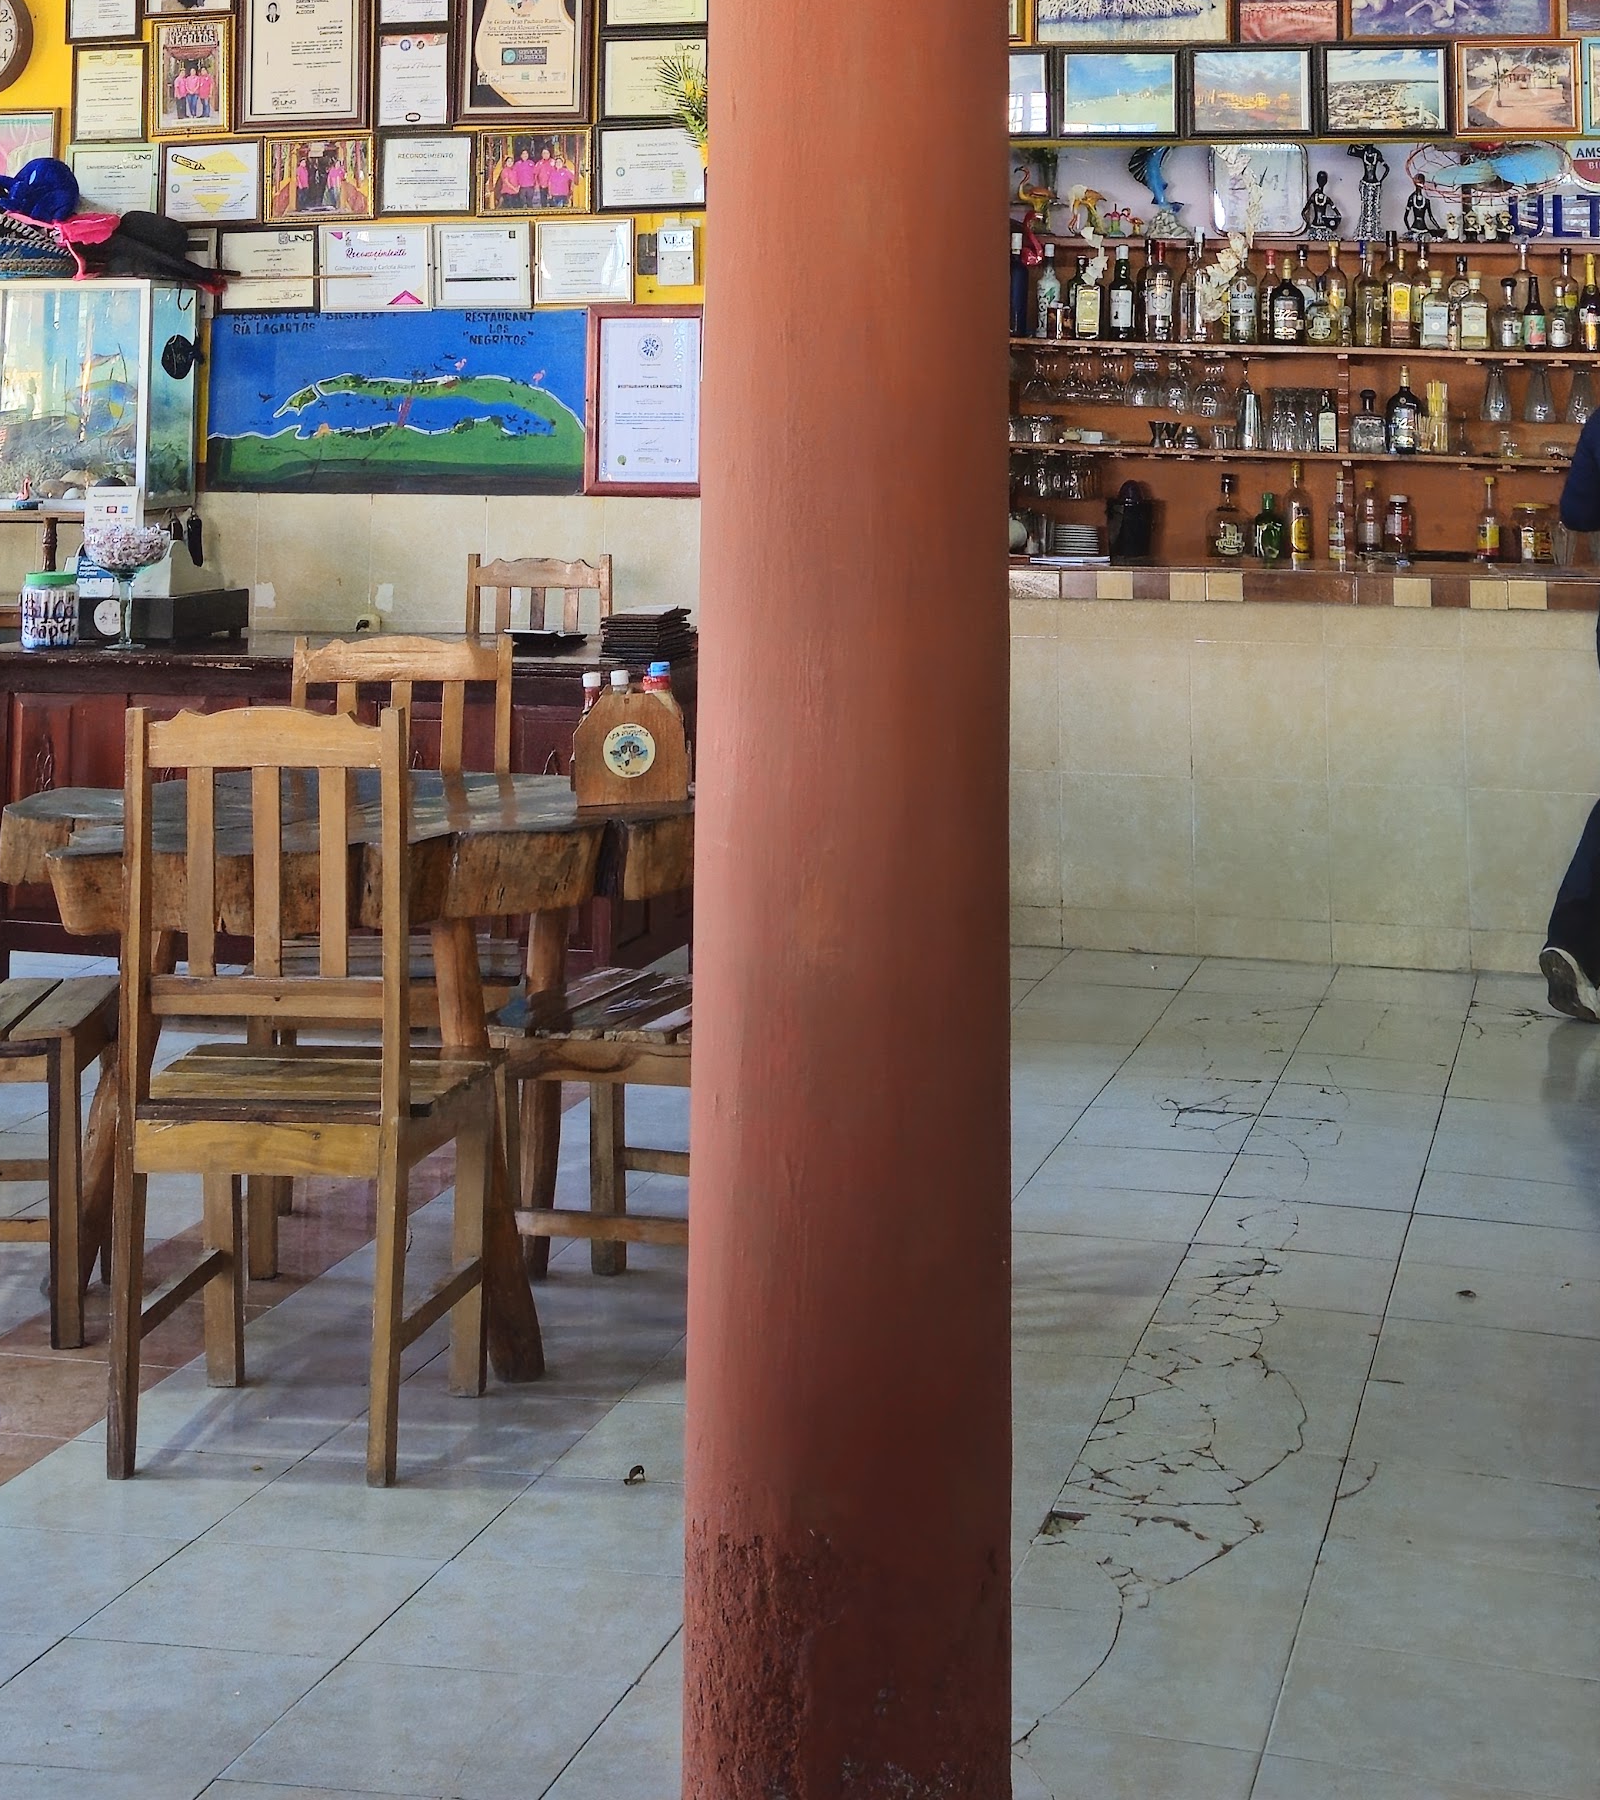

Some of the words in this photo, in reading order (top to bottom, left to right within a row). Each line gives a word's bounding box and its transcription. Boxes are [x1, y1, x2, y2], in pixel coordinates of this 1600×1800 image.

[0, 9, 9, 23] 2
[5, 28, 13, 42] 3
[0, 48, 7, 62] 4
[289, 232, 313, 243] UNO
[464, 312, 535, 323] RESTAURANT
[489, 324, 509, 334] LOS
